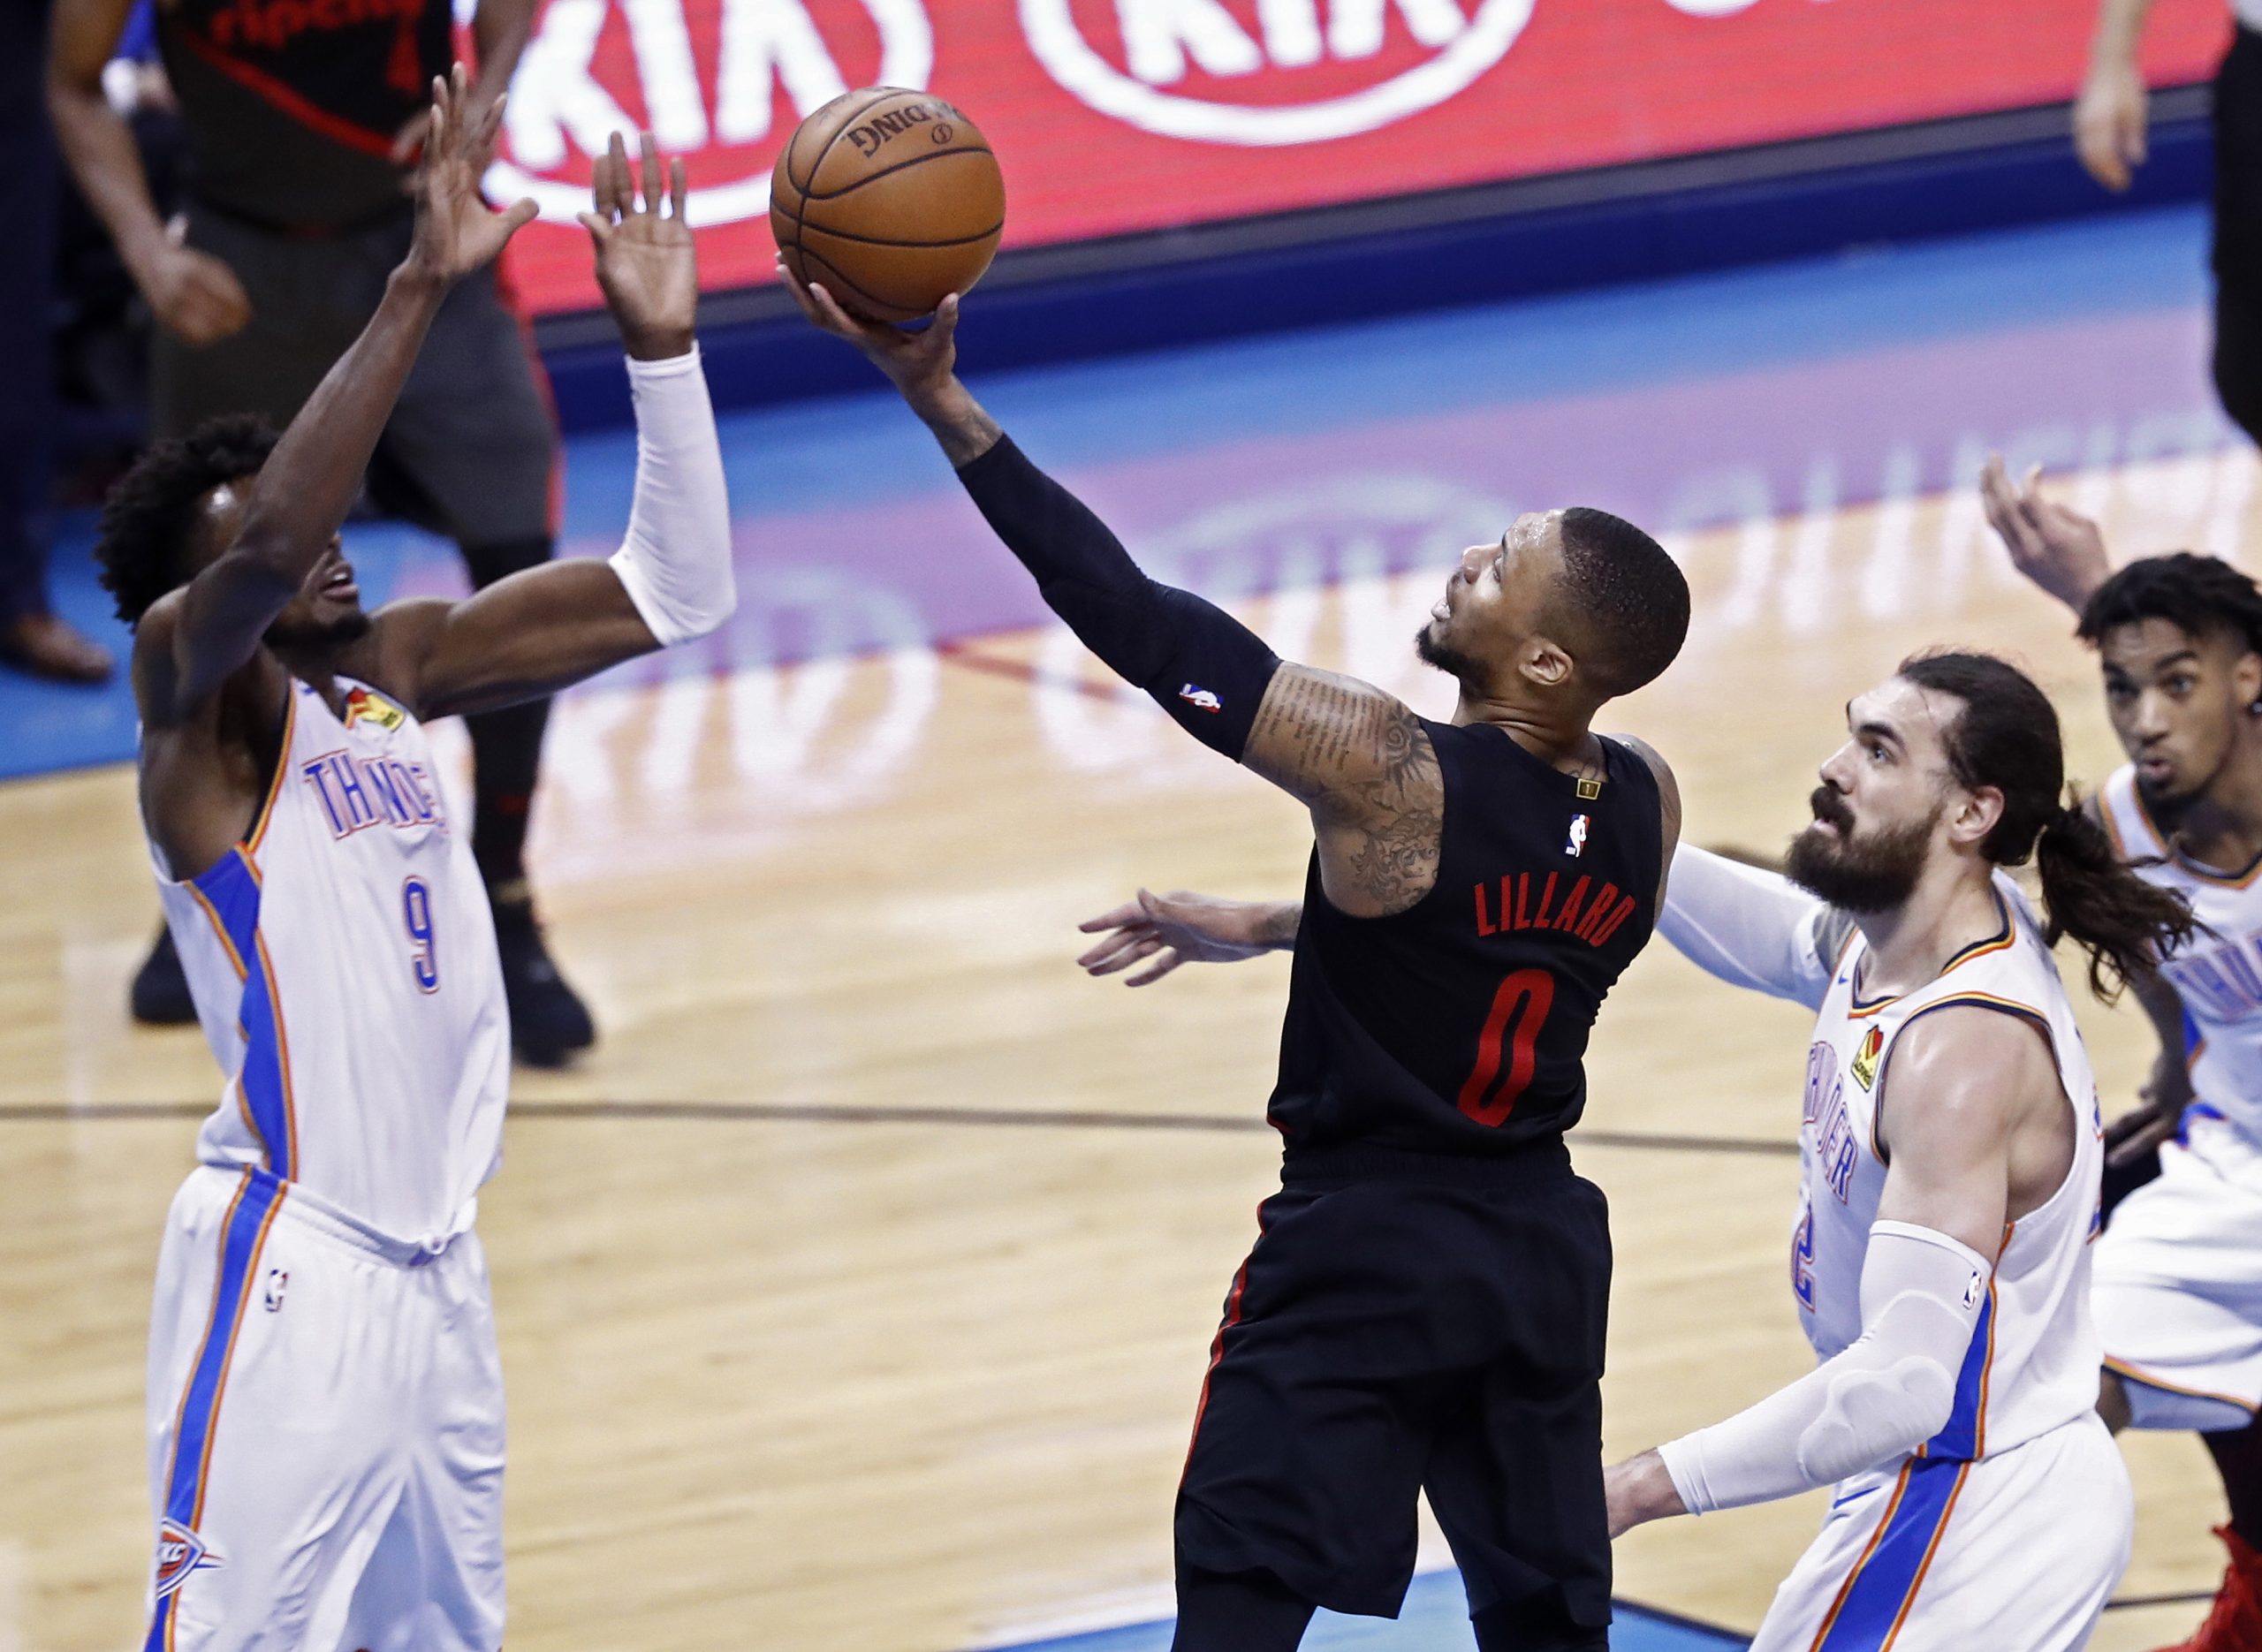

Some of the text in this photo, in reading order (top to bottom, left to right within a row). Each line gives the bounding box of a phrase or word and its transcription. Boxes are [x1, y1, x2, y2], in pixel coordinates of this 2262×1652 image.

[403, 875, 440, 994] 9
[1474, 871, 1636, 948] LILLARD
[1456, 968, 1554, 1127] 0
